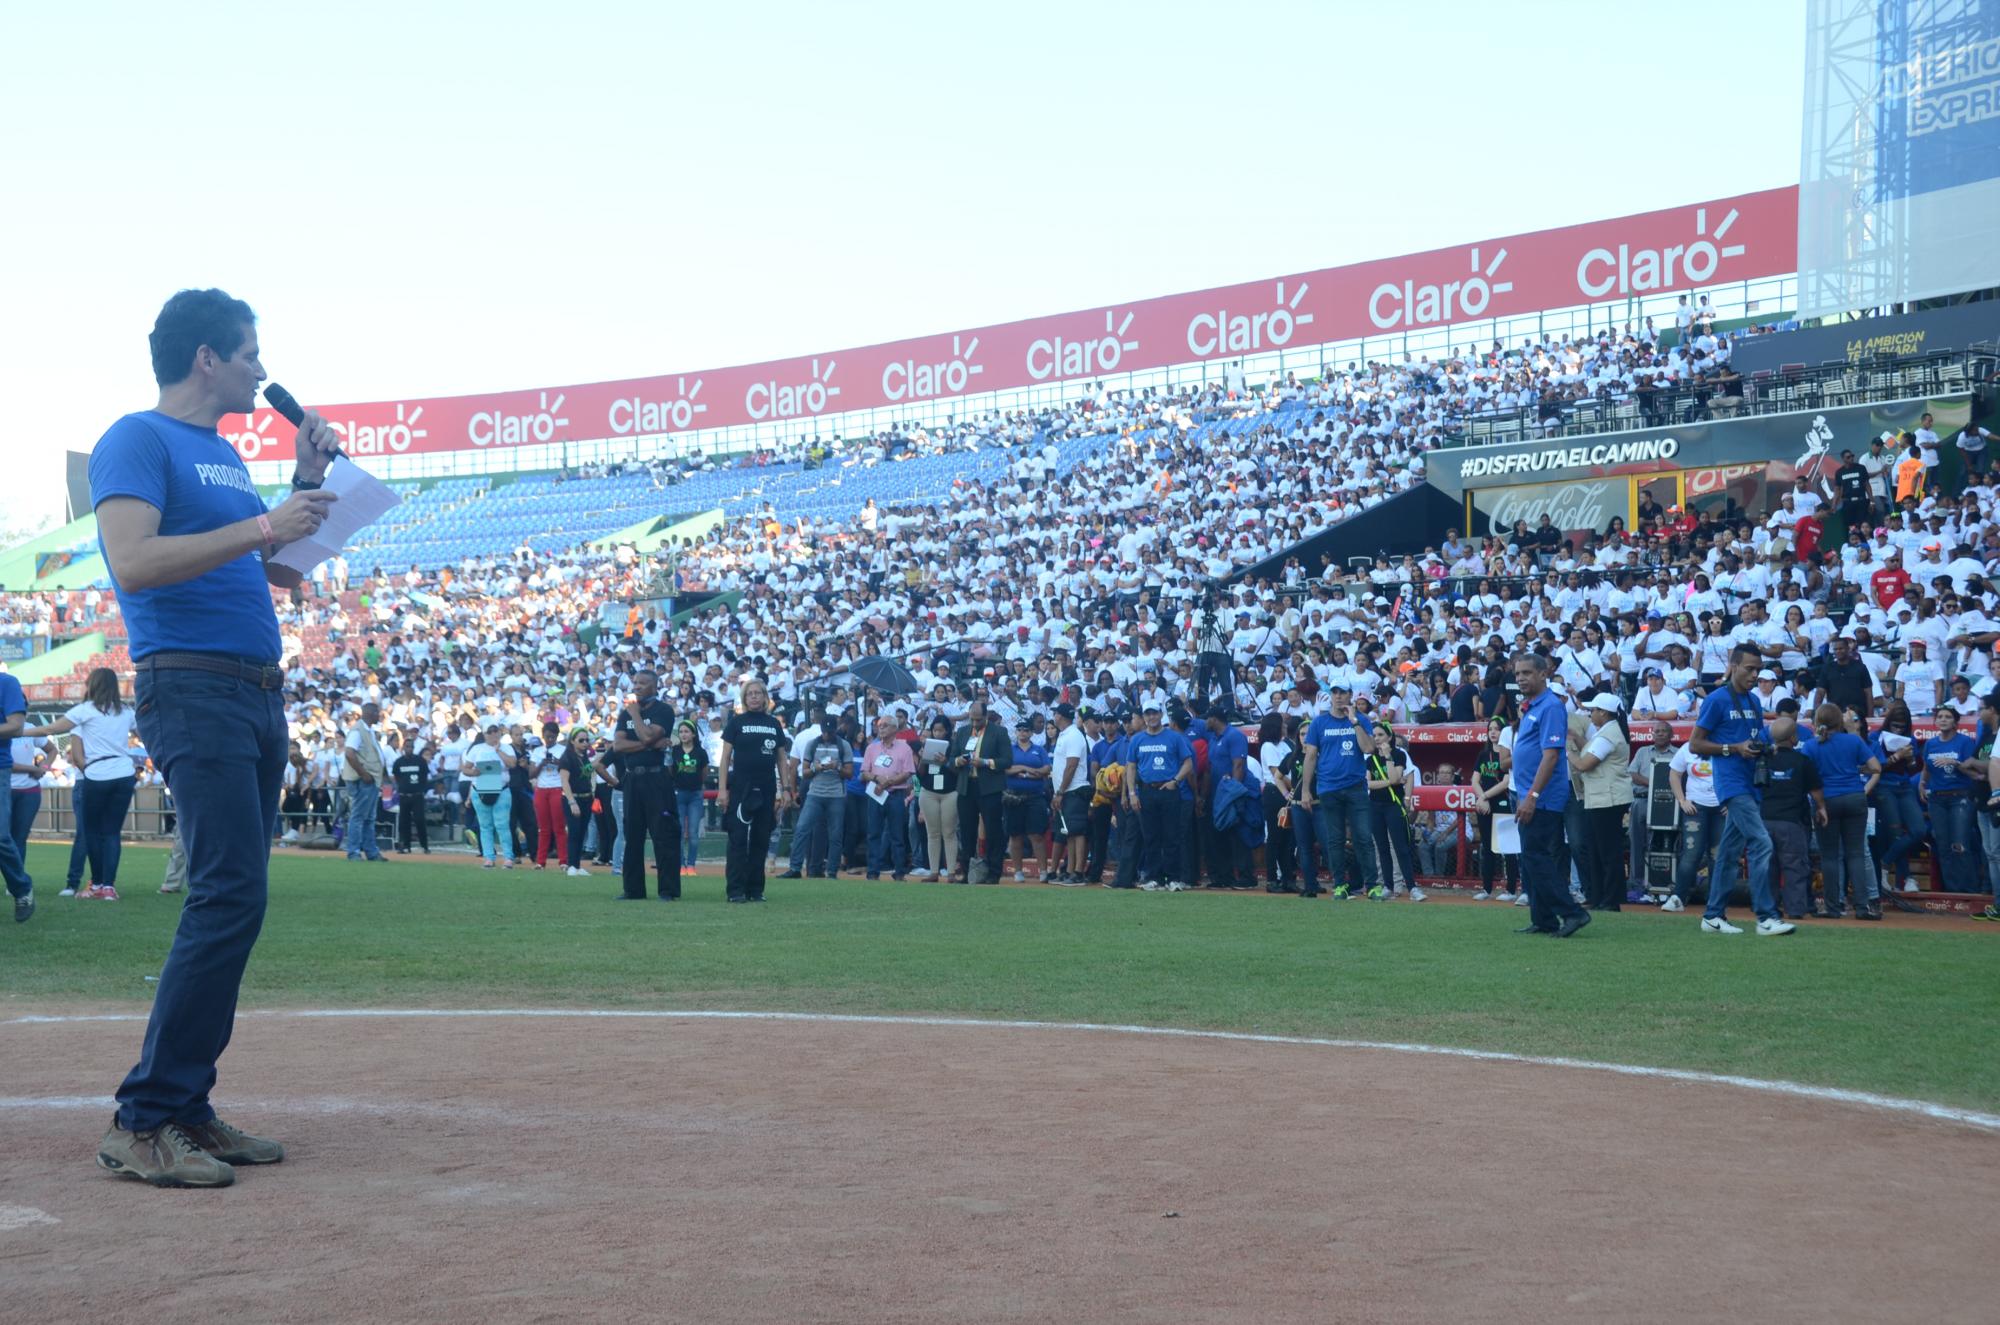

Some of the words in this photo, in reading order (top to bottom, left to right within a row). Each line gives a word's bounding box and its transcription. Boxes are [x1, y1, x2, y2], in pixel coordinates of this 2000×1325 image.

[1880, 36, 2000, 98] AMERIC
[1576, 240, 1719, 298] Claro
[1368, 277, 1490, 330] Claro
[1186, 309, 1294, 356] Claro
[1846, 339, 1862, 352] LA
[1864, 331, 1925, 349] AMBICIÓN
[1026, 335, 1121, 379] Claro
[882, 359, 968, 401] Claro
[608, 397, 692, 434] Claro
[745, 381, 826, 420] Claro
[468, 411, 553, 446] Claro
[1460, 438, 1679, 478] #DISFRUTAELCAMINO
[1447, 733, 1470, 742] Claro
[1630, 732, 1653, 742] Claro
[1445, 789, 1476, 809] Cla
